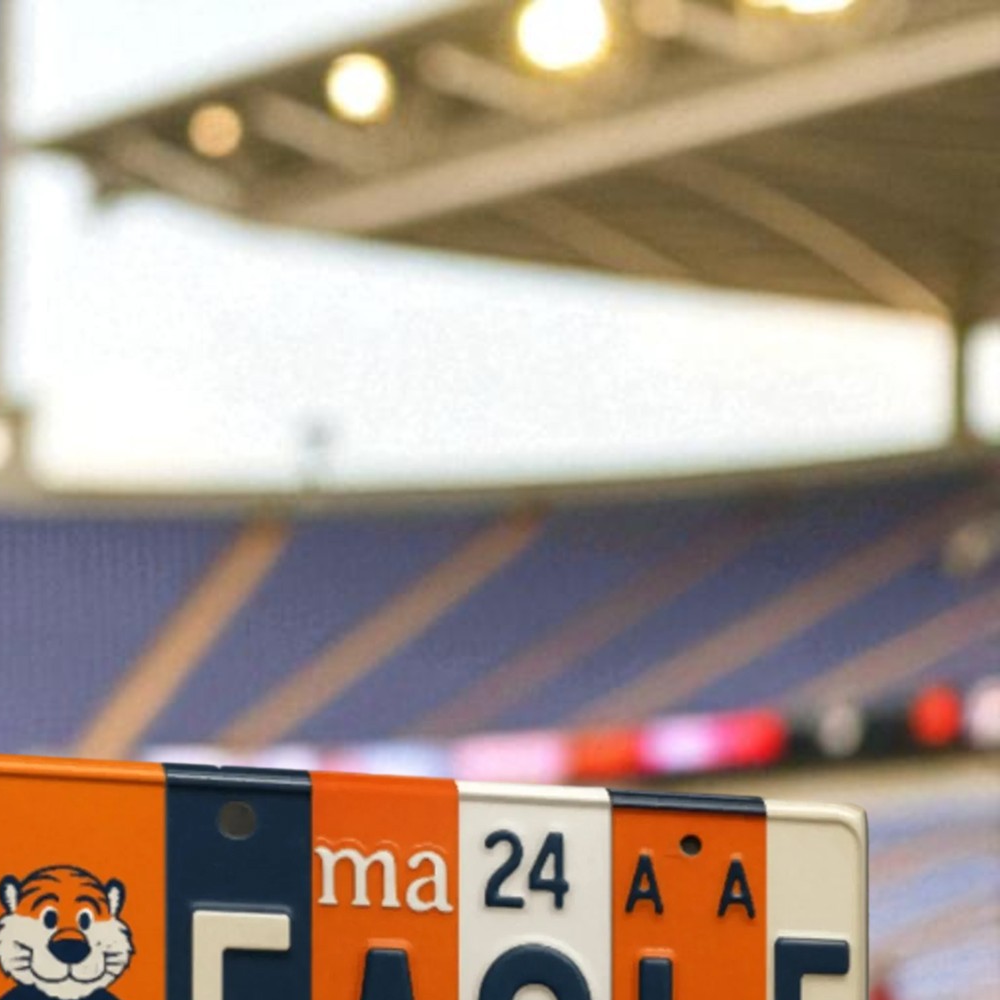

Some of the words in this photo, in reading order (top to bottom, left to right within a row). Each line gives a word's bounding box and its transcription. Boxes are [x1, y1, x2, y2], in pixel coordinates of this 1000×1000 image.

[314, 845, 452, 914] ma
[484, 829, 568, 909] 24
[624, 853, 664, 914] A
[717, 858, 756, 919] A
